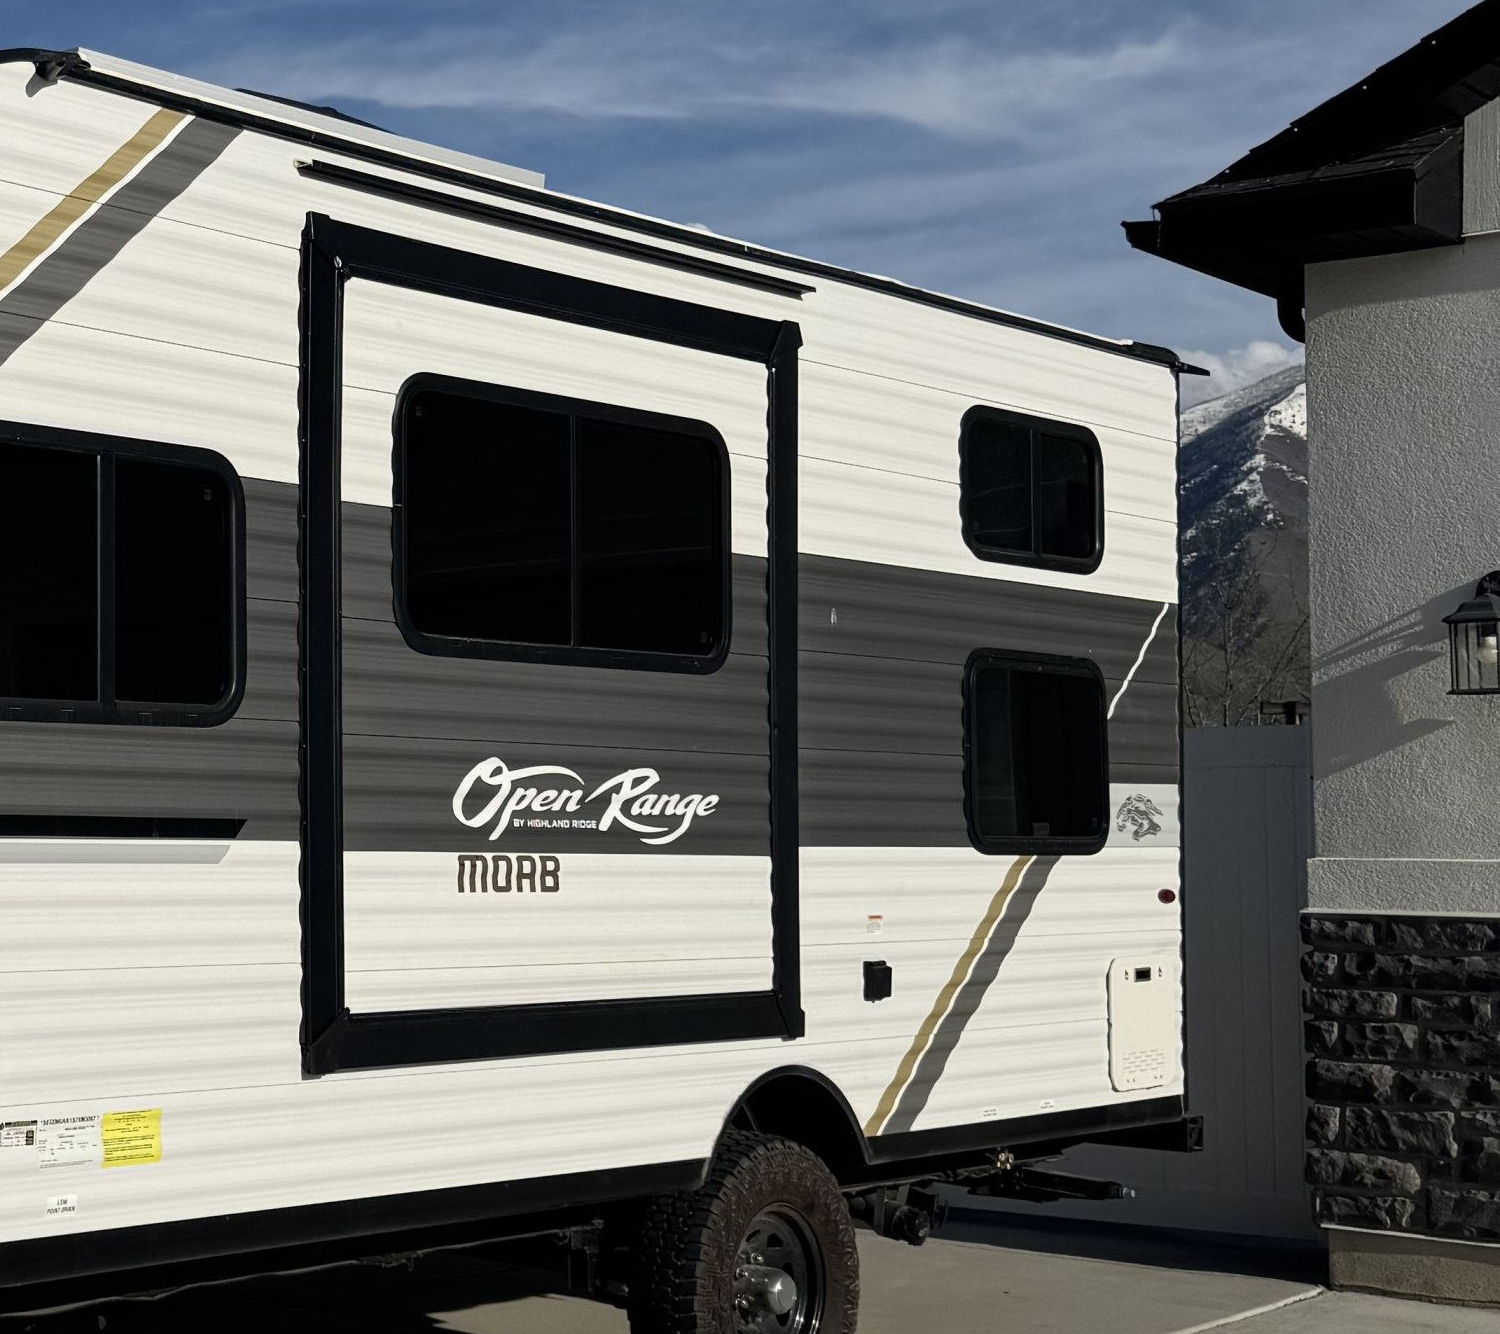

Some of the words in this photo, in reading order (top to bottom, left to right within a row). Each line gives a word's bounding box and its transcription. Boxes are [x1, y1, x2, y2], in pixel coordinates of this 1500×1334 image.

[452, 756, 586, 841] Open
[584, 767, 720, 845] Range
[512, 818, 525, 828] BY
[527, 818, 570, 829] HIGHLAND
[571, 819, 598, 829] RIDGE
[457, 854, 561, 893] MOAB
